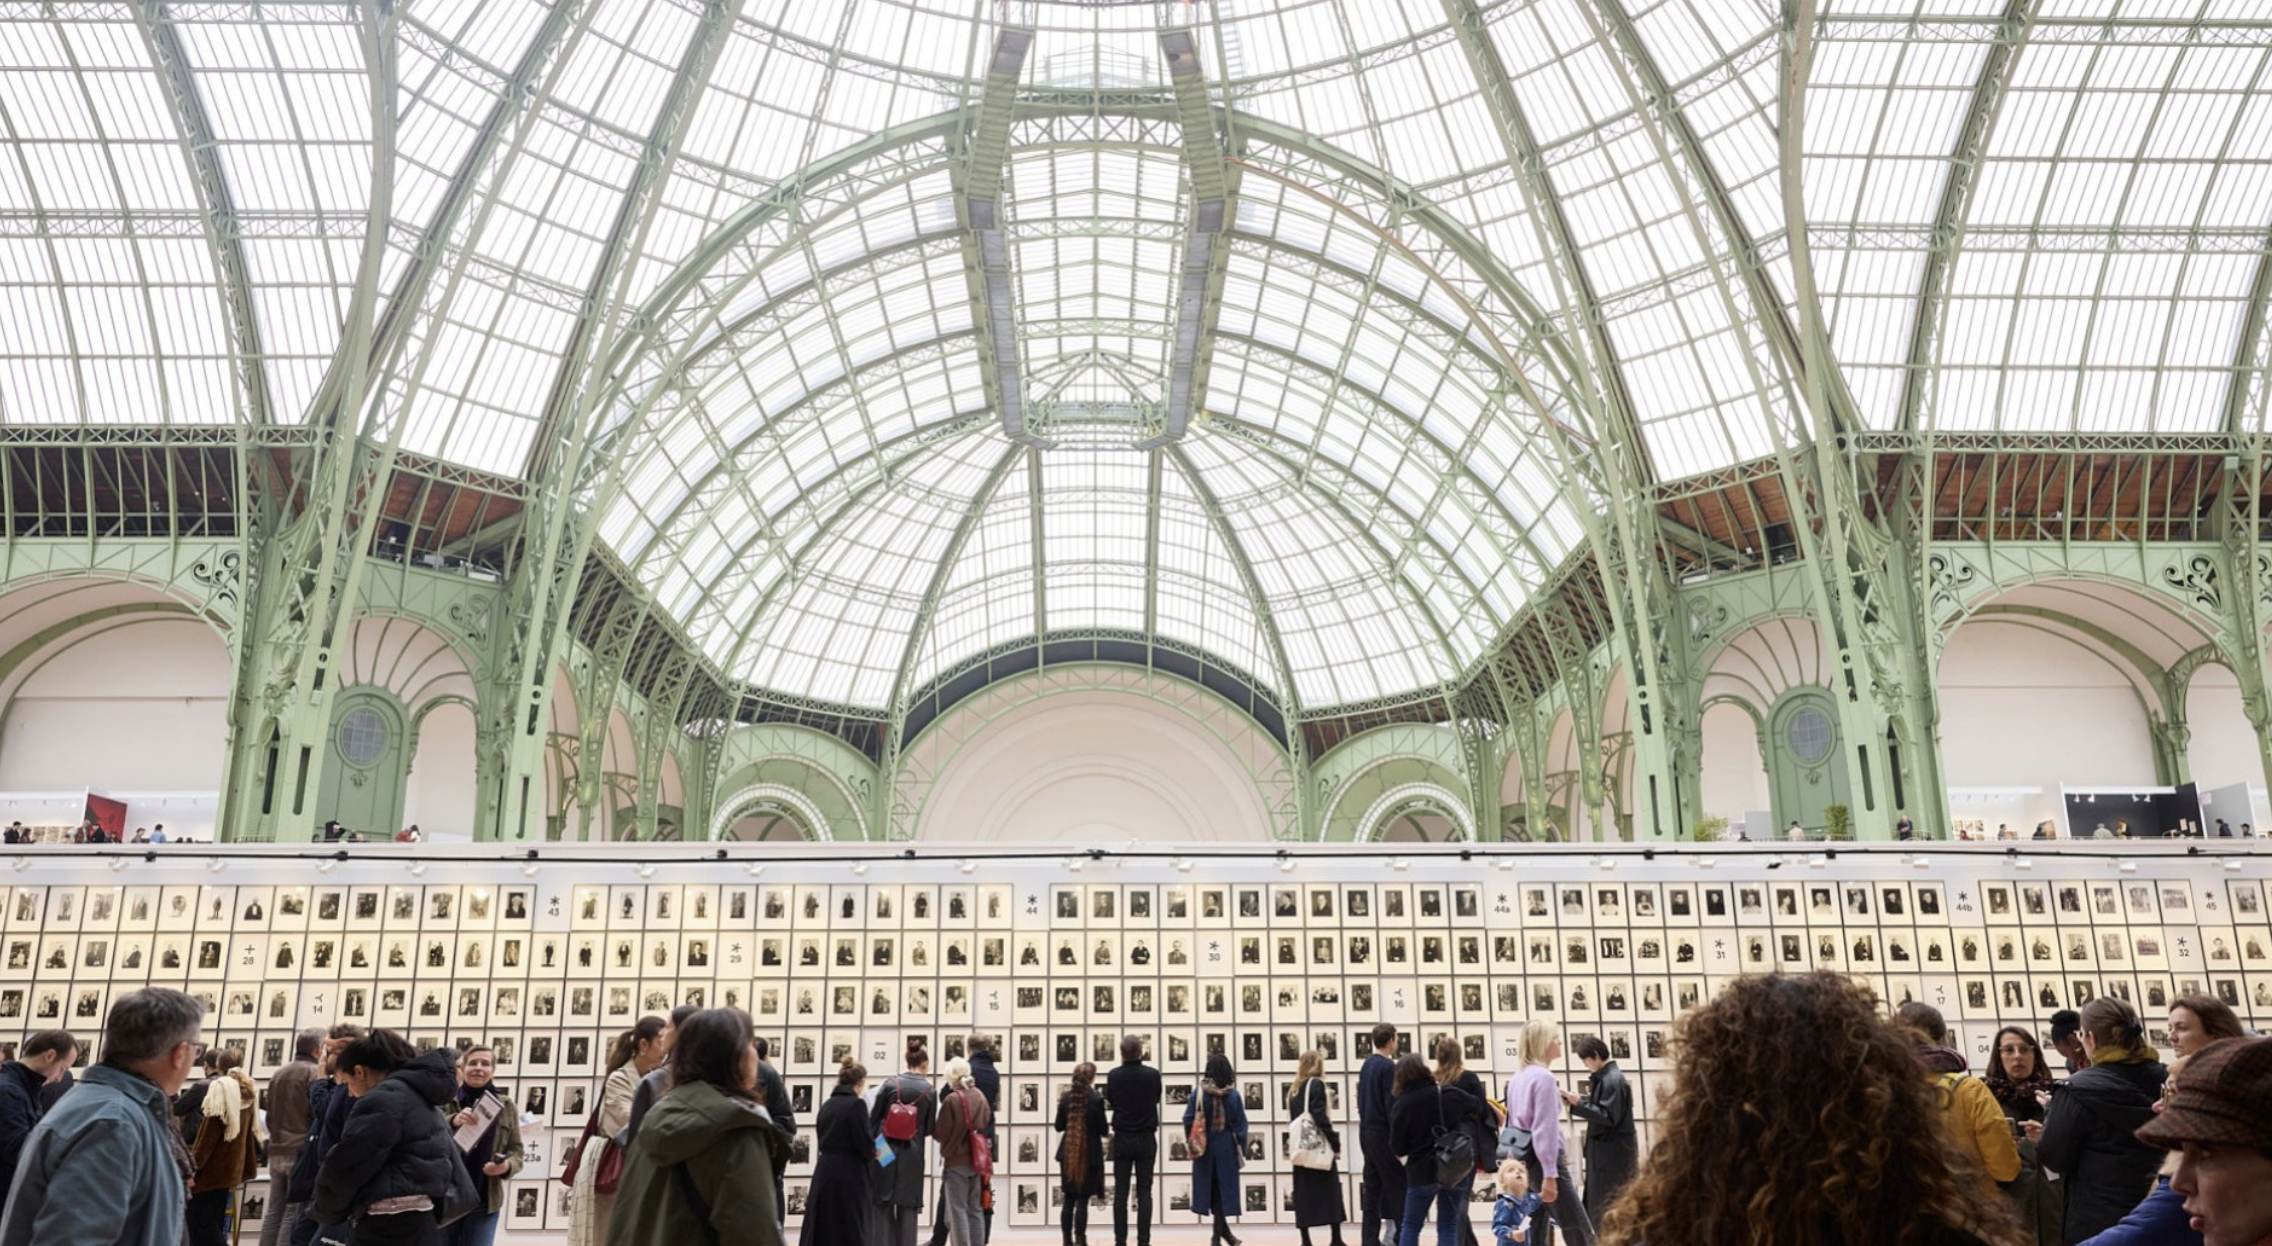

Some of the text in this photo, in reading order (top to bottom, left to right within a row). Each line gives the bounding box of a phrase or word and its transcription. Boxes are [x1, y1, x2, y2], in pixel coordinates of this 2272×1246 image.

[1495, 905, 1511, 914] 44a
[1956, 904, 1973, 913] 44b
[2206, 902, 2217, 911] 45
[548, 909, 561, 917] 43
[1026, 907, 1039, 916] 44
[1208, 953, 1221, 962] 30
[1717, 951, 1726, 960] 31
[2179, 949, 2191, 958] 32
[243, 957, 255, 966] 28
[730, 955, 742, 964] 29
[1937, 996, 1946, 1006] 17
[313, 1005, 323, 1015] 14
[989, 1002, 1000, 1011] 15
[1506, 1048, 1518, 1057] 03
[1978, 1045, 1990, 1054] 04
[874, 1052, 887, 1061] 02
[524, 1154, 542, 1163] 23a
